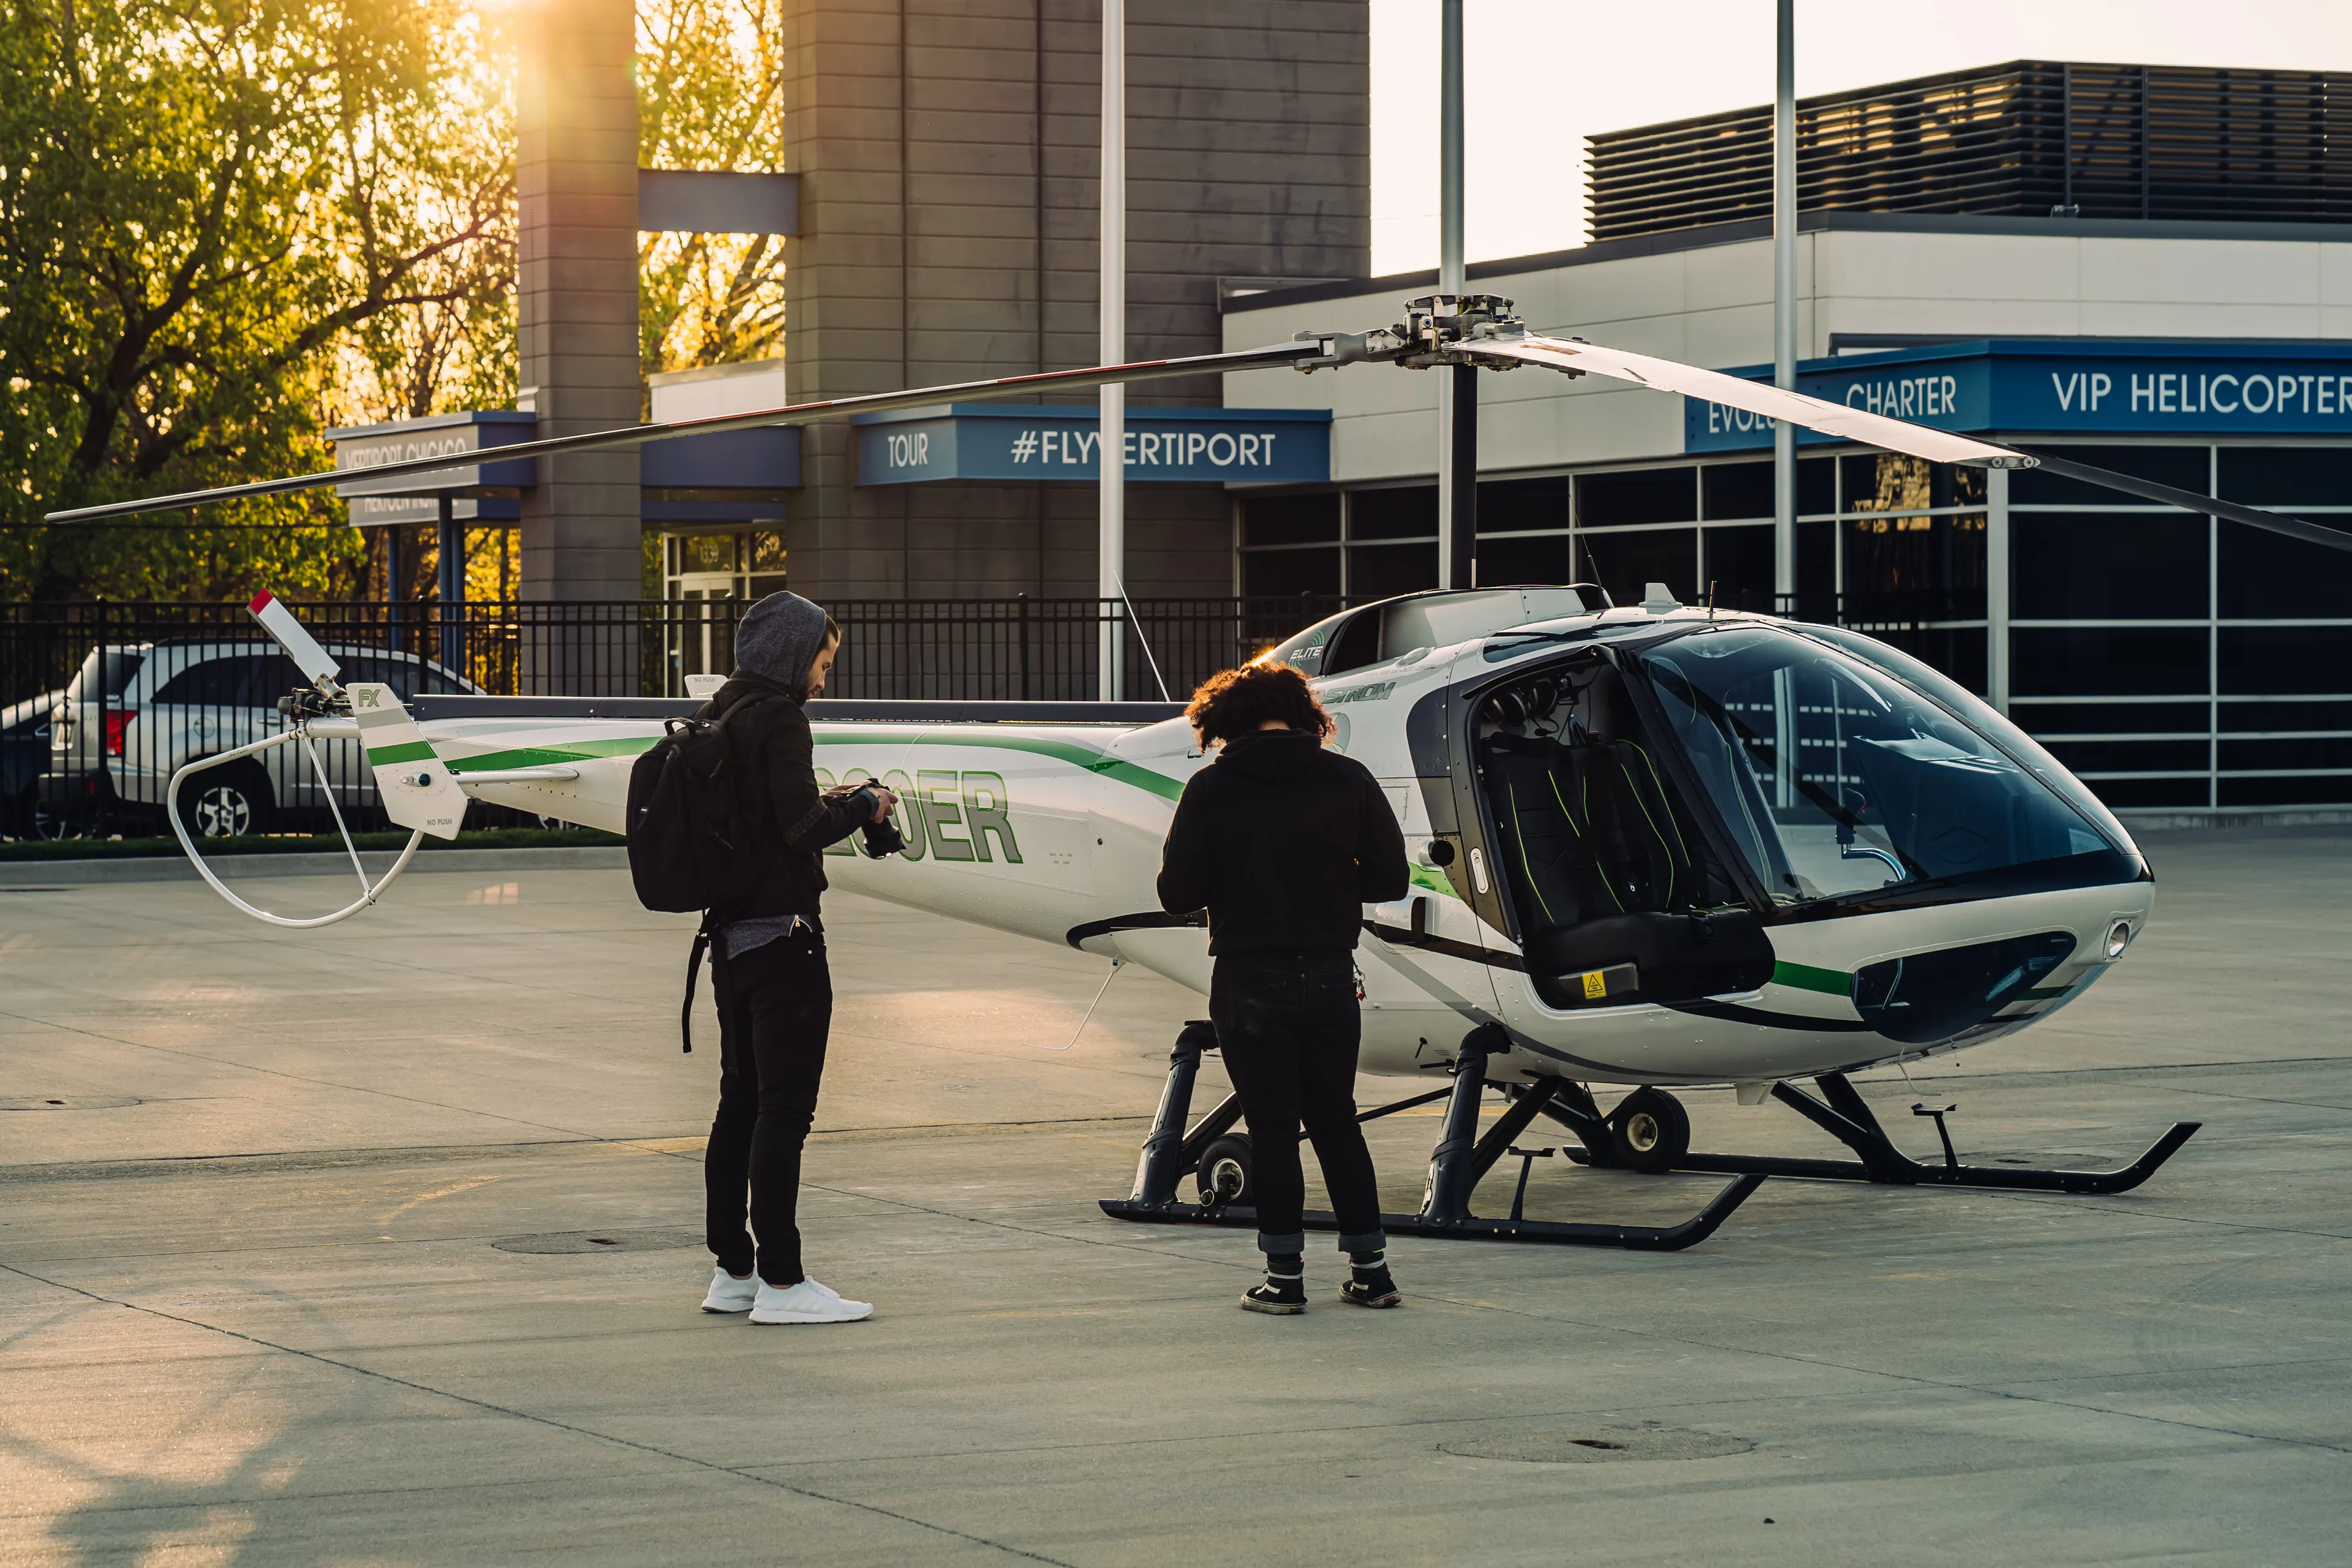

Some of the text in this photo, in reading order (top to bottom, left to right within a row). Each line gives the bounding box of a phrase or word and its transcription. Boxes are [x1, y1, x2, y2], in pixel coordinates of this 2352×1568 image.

[1709, 375, 1956, 434] EVOL CHARTER
[2052, 373, 2352, 413] VIP HELICOPTER
[888, 432, 929, 467] TOUR
[1290, 646, 1324, 660] ELITE
[358, 689, 380, 707] FX
[1318, 681, 1396, 704] NSTROM
